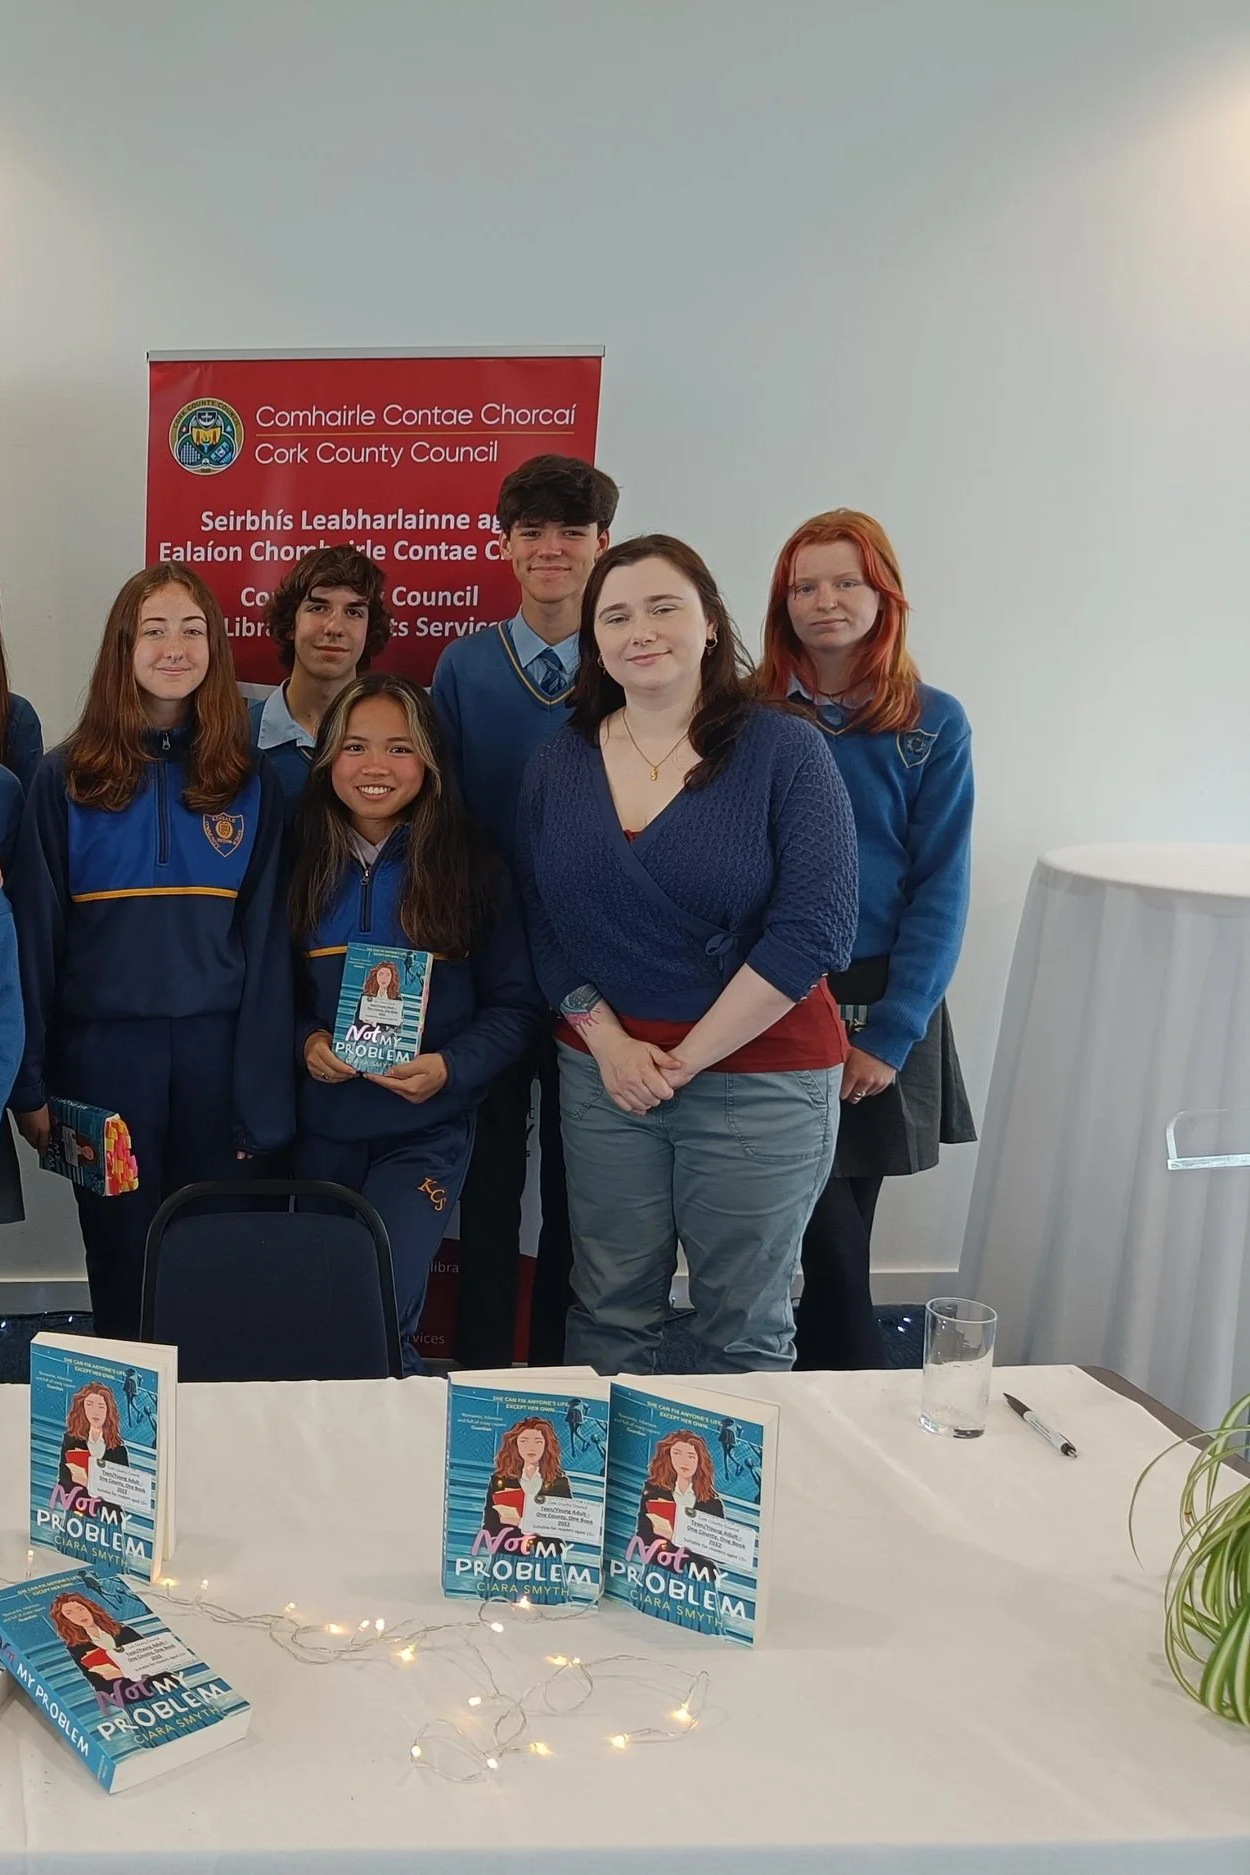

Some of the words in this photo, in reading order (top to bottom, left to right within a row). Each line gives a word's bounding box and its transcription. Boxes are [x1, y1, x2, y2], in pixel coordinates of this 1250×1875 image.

[256, 405, 376, 428] Comhairle
[383, 404, 473, 426] Contae
[480, 403, 577, 426] Chorcaí
[255, 443, 309, 465] Cork
[316, 442, 404, 468] County
[410, 441, 498, 463] Council
[201, 510, 294, 531] Seirbhís
[301, 508, 470, 530] Leabharlainne
[478, 513, 501, 534] ag
[159, 540, 242, 562] Ealaíon
[394, 540, 477, 561] Contae
[392, 585, 479, 607] Council
[416, 616, 498, 637] Servic
[336, 1041, 410, 1063] PROBLEM
[345, 1024, 381, 1043] Not
[379, 1035, 402, 1048] MY
[49, 1484, 101, 1518] Not
[101, 1506, 132, 1531] MY
[36, 1509, 146, 1560] PROBLEM
[471, 1527, 536, 1556] Not
[535, 1542, 574, 1560] MY
[54, 1535, 88, 1553] CIARA
[91, 1547, 129, 1567] SMYTH
[625, 1536, 690, 1573] Not
[687, 1562, 728, 1588] MY
[455, 1558, 592, 1585] PROBLEM
[477, 1582, 518, 1593] CIARA
[524, 1586, 570, 1596] SMYTH
[610, 1560, 747, 1620] PROBLEM
[629, 1590, 671, 1612] CIARA
[677, 1605, 724, 1628] SMYTH
[17, 1663, 35, 1687] MY
[35, 1686, 90, 1757] PROBLEM
[94, 1678, 154, 1717] Not
[152, 1671, 188, 1696] MY
[96, 1684, 230, 1742] PROBLEM
[134, 1725, 175, 1745] CIARA
[176, 1706, 220, 1729] SMYTH
